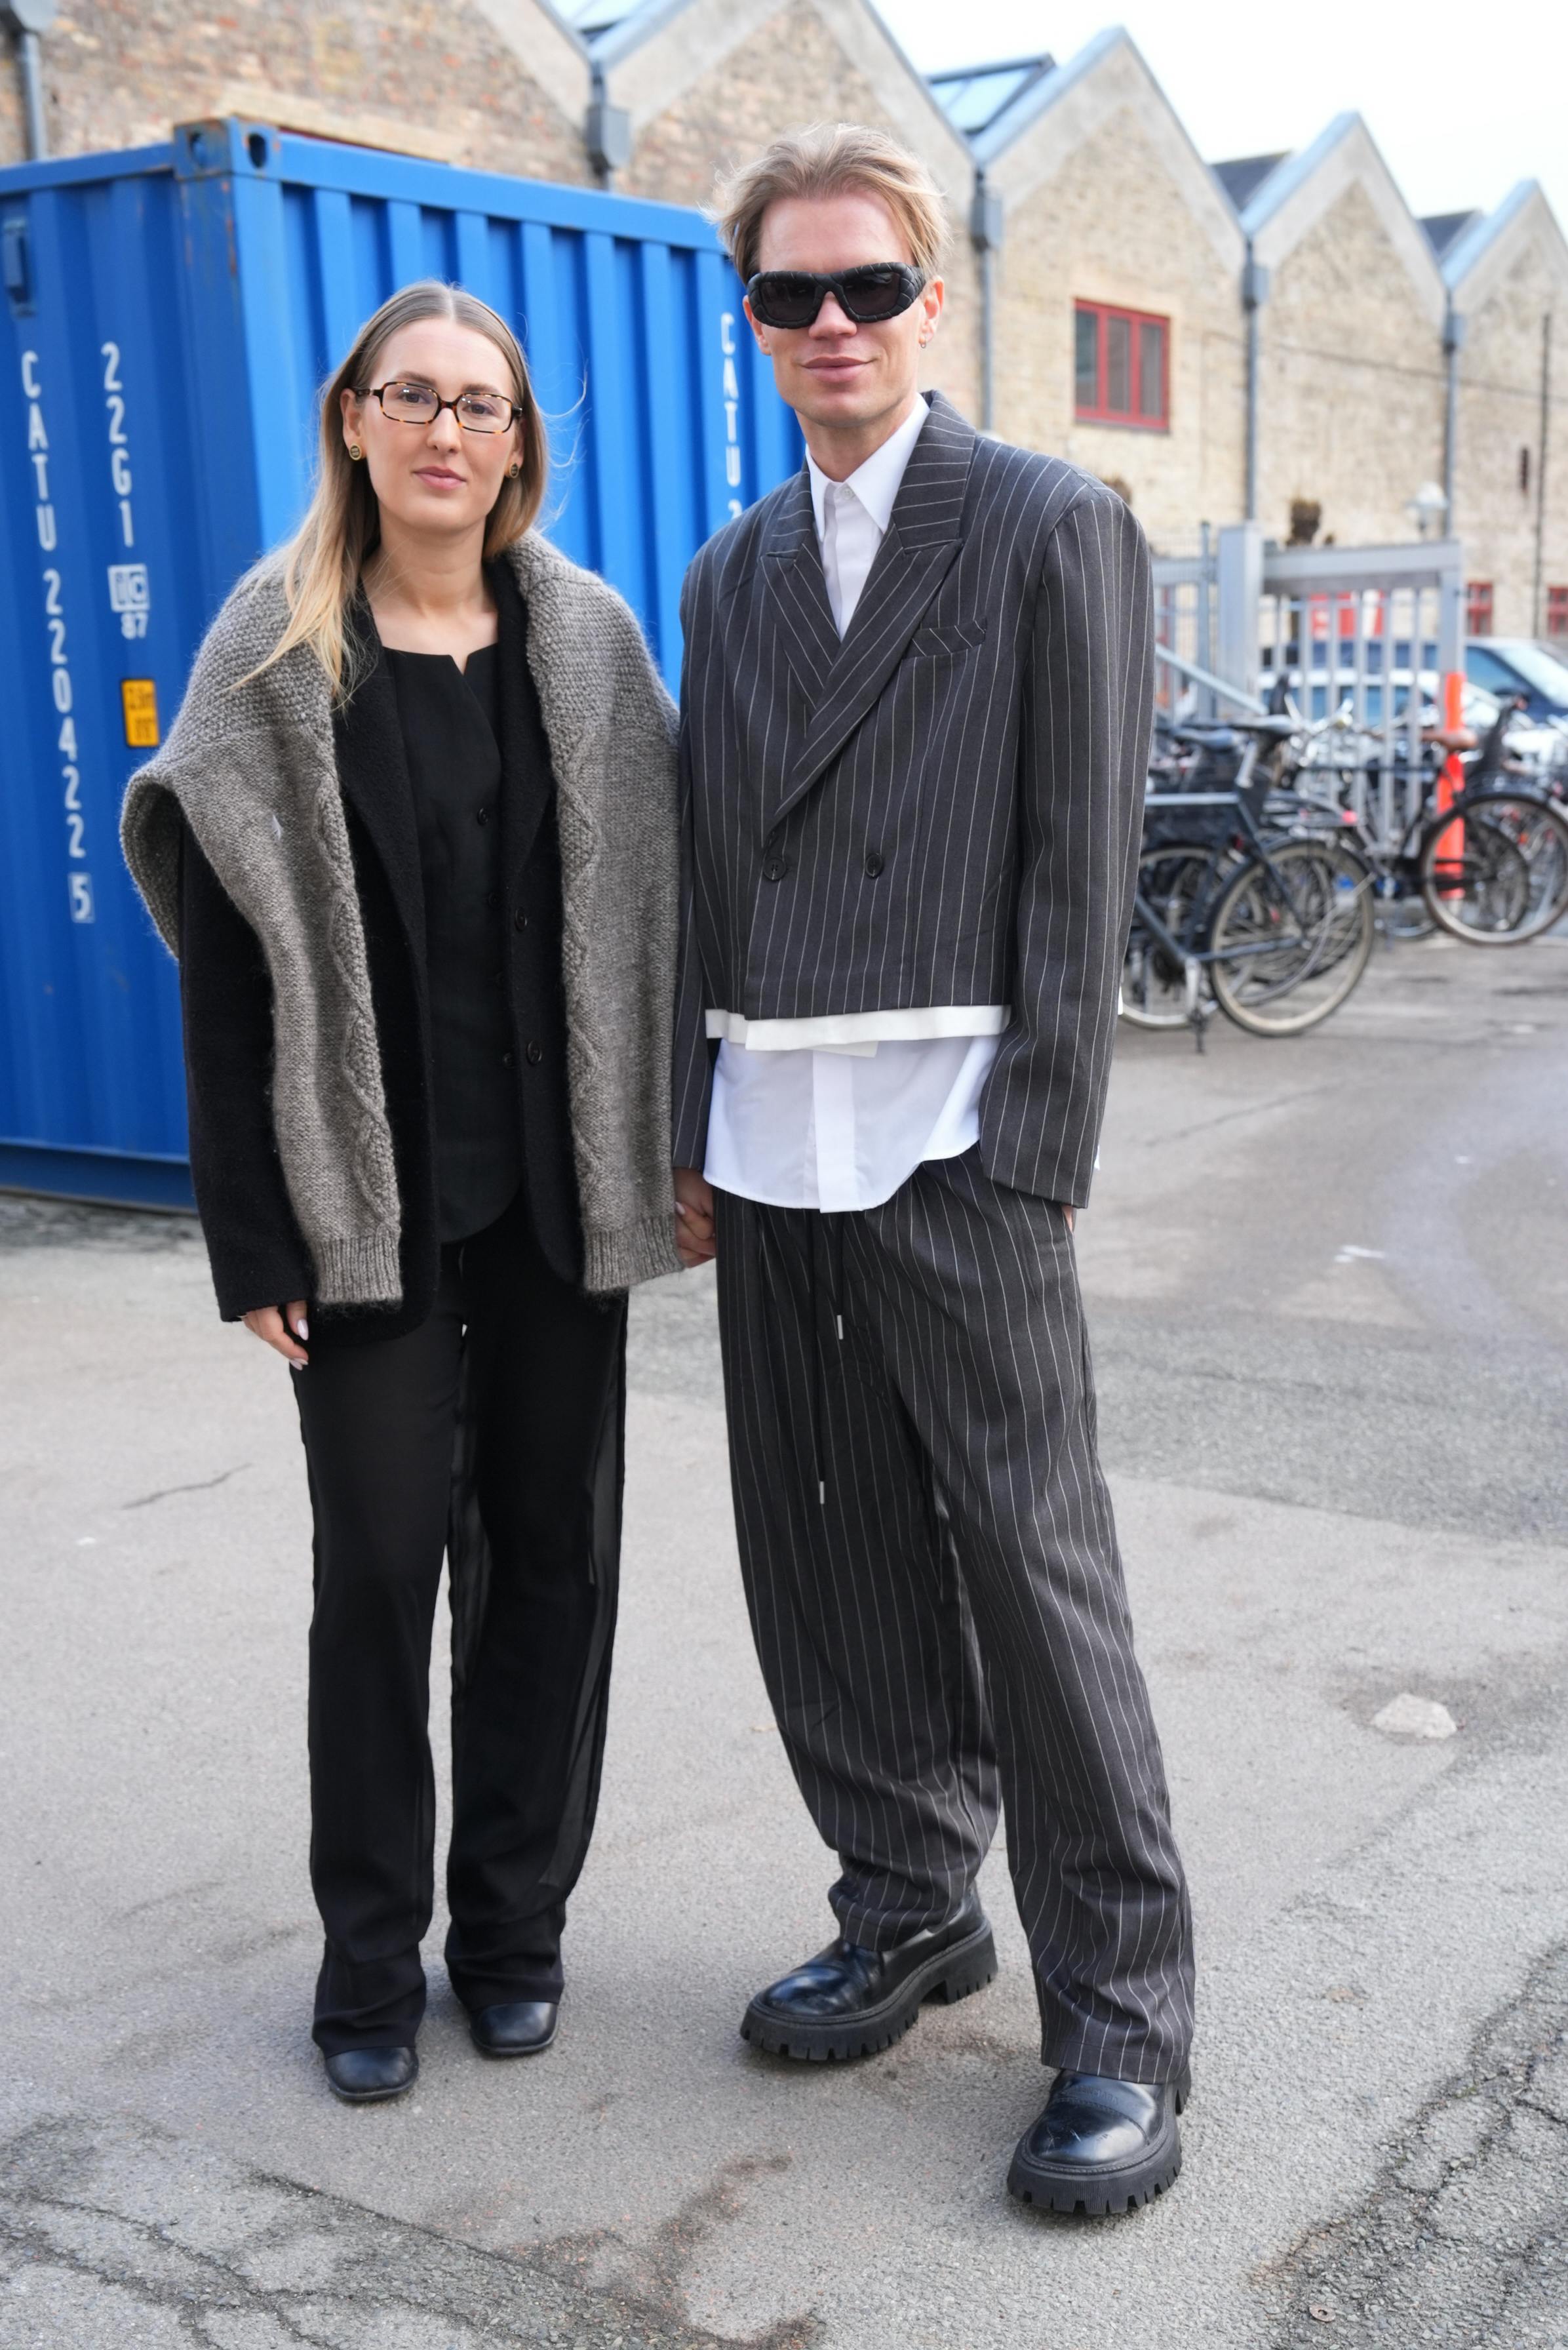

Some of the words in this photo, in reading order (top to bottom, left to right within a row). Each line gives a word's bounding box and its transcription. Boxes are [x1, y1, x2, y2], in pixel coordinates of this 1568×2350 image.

[101, 342, 134, 547] 22G1
[721, 311, 741, 487] CATU
[22, 350, 57, 551] CATU
[43, 568, 85, 858] 220422
[71, 873, 92, 922] 5
